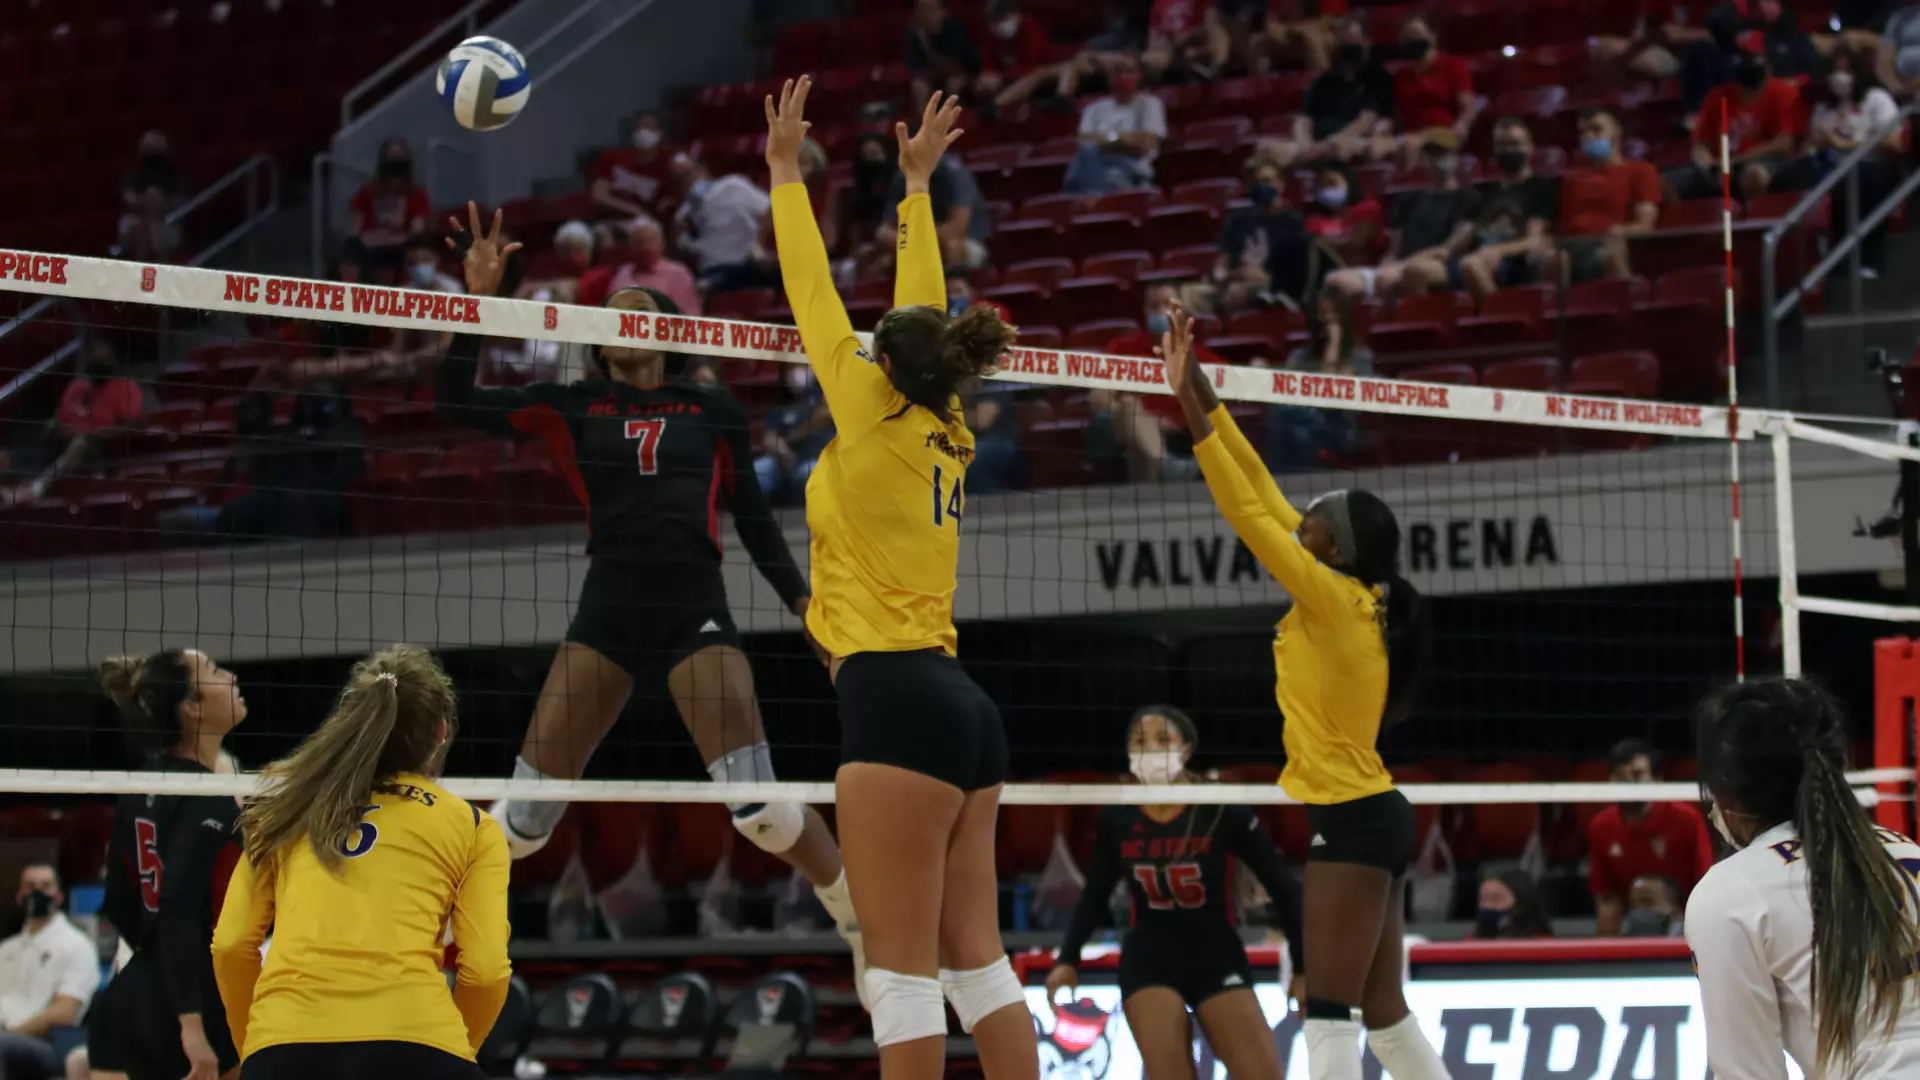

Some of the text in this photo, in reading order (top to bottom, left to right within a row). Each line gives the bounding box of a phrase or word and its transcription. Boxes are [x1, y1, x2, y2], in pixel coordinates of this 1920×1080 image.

[0, 252, 68, 285] PACK
[224, 274, 481, 323] NC STATE WOLFPACK
[619, 313, 806, 353] NC STATE WOLFP
[1065, 354, 1165, 384] WOLFPACK
[1272, 373, 1449, 409] NC STATE WOLFPACK
[1546, 396, 1702, 427] NC STATE WOLFPACK
[624, 417, 666, 475] 7
[933, 465, 963, 538] 14
[1096, 516, 1558, 592] VALVA RENA
[334, 804, 382, 859] 6
[135, 818, 164, 912] 5
[1134, 863, 1206, 910] 15
